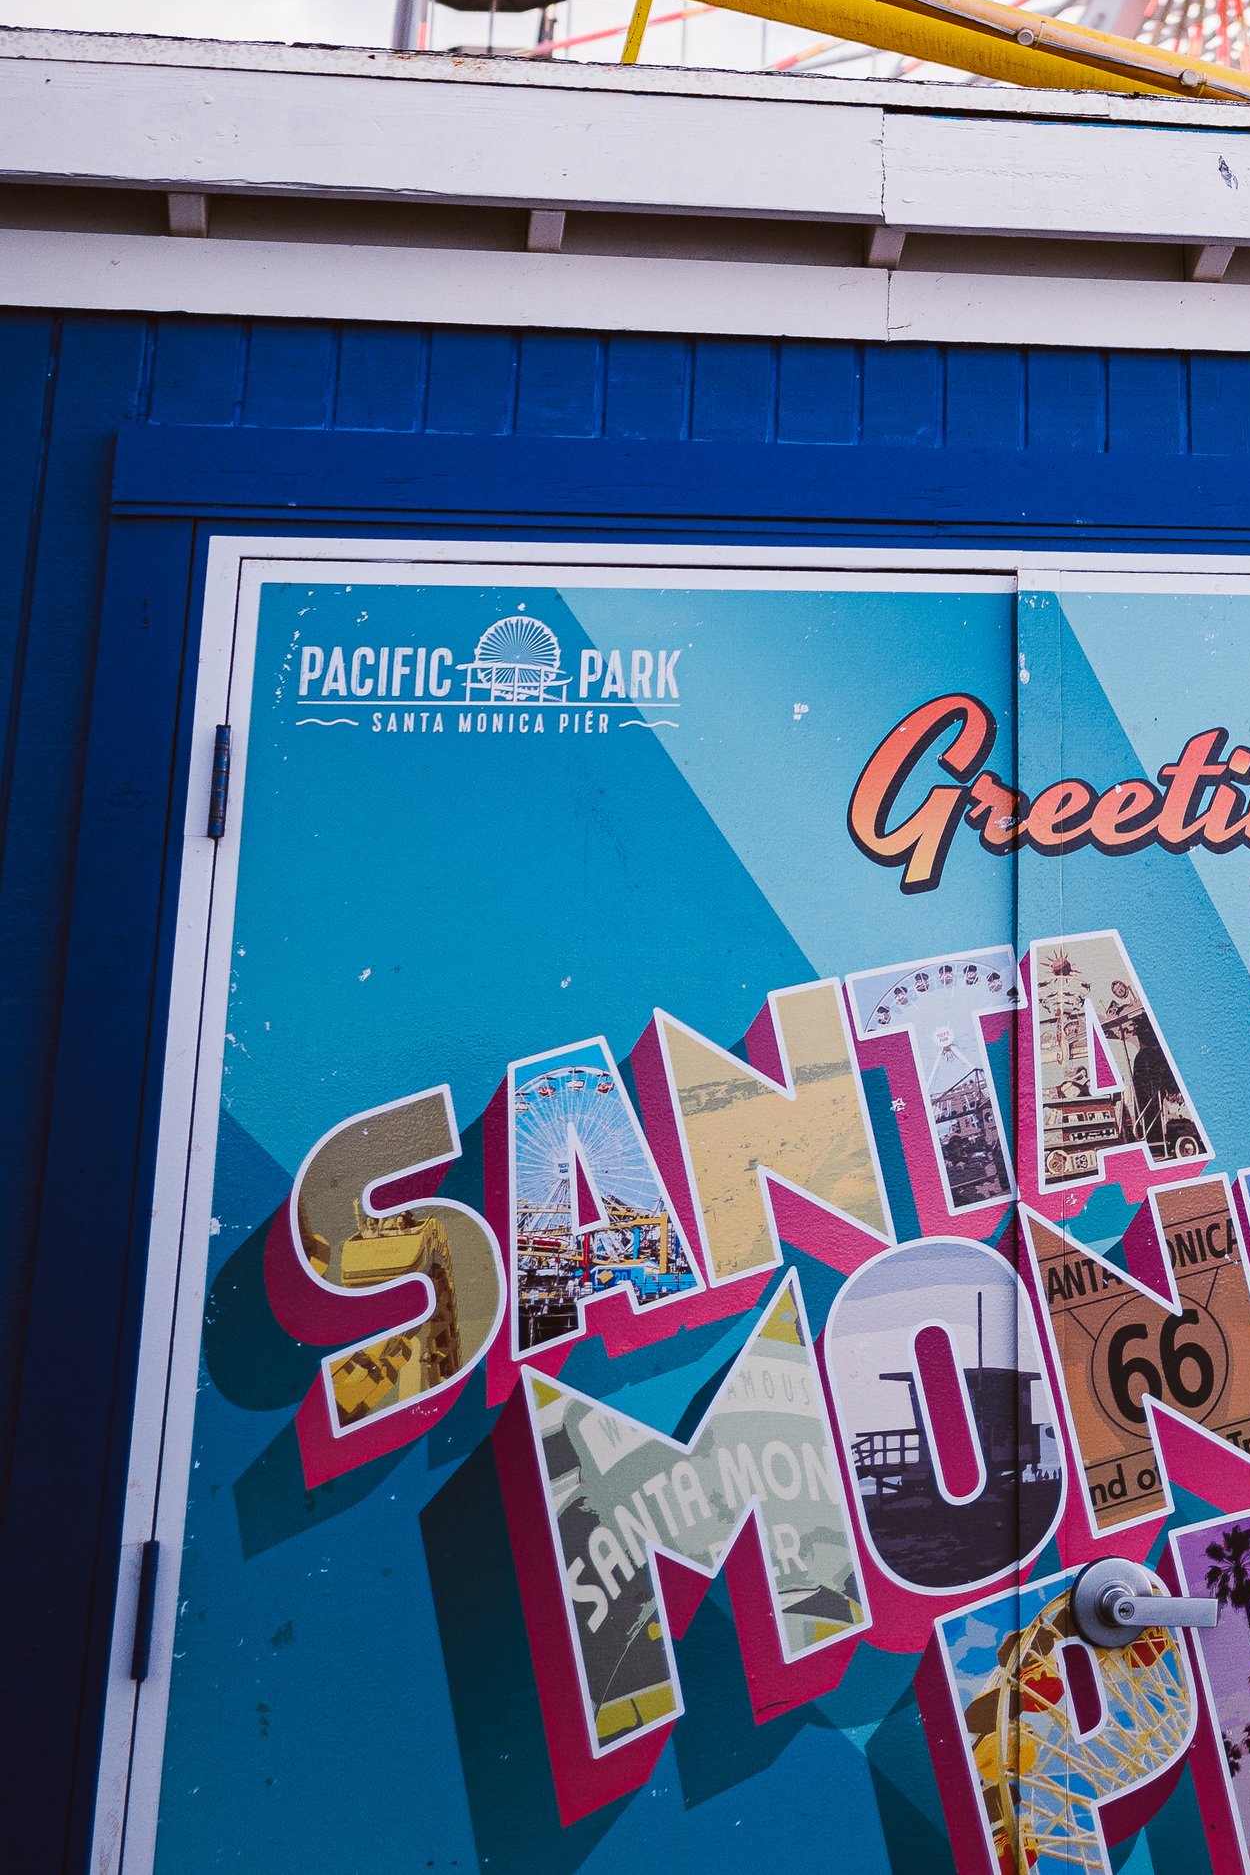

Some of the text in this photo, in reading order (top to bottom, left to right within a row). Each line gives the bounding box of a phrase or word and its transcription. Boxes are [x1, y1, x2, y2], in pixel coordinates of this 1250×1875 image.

[299, 646, 682, 699] PACIFIC PARK
[372, 712, 444, 733] SANTA
[458, 713, 545, 733] MONICA
[290, 928, 1216, 1438] SANTA
[1046, 1258, 1124, 1304] ANTA
[1108, 1309, 1214, 1423] 66
[567, 1461, 712, 1633] SANTA
